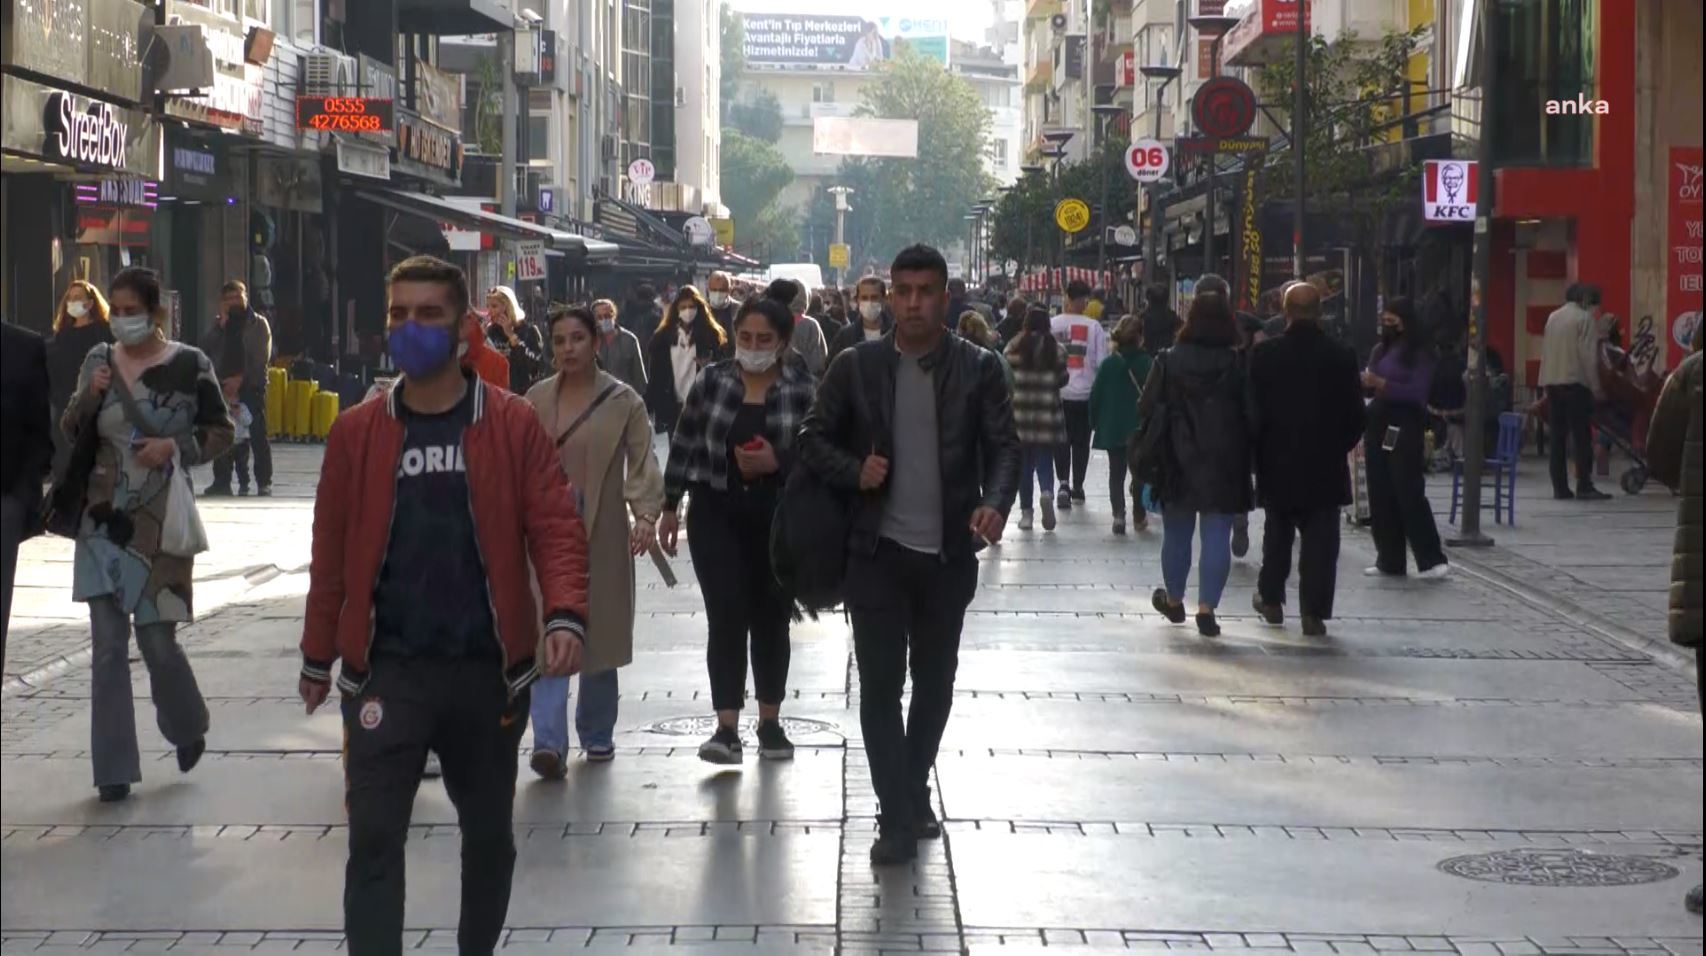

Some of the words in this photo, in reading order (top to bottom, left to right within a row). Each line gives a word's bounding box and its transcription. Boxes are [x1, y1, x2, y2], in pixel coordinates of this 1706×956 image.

[743, 19, 782, 31] Kent'in
[784, 19, 802, 32] Tıp
[804, 20, 862, 33] Merkezleri
[743, 33, 791, 45] Avantajlı
[793, 34, 846, 46] Fiyatlarla
[742, 44, 819, 57] Hizmetinizde!
[324, 98, 366, 113] 0555
[58, 90, 128, 168] StreetBox
[308, 114, 381, 130] 4276568
[1130, 147, 1163, 168] 06
[1136, 168, 1160, 177] döner
[626, 182, 652, 210] KING
[1679, 184, 1703, 198] OY
[1433, 205, 1471, 219] KFC
[1676, 245, 1703, 263] TO
[518, 256, 537, 277] 119
